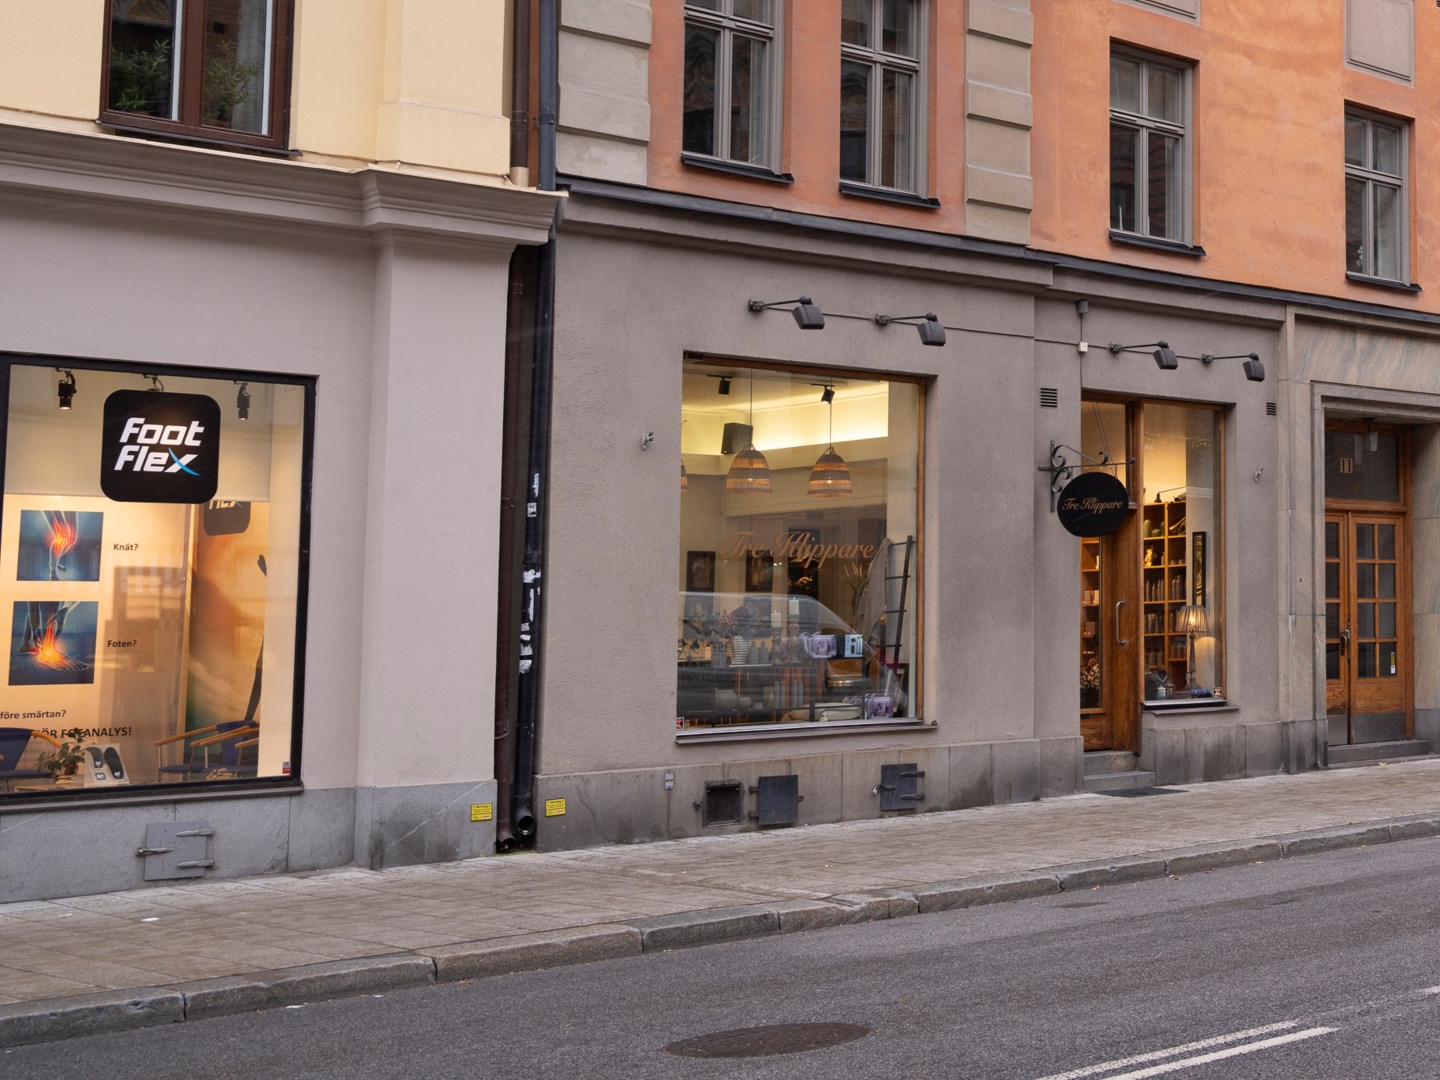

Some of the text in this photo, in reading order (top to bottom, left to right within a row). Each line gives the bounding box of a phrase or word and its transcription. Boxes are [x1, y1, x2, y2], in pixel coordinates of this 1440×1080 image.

[119, 417, 205, 446] Foot
[114, 445, 201, 476] Flex
[1062, 497, 1122, 514] Tre Klippare
[113, 543, 139, 551] Knät?
[770, 532, 877, 568] Klippare
[107, 640, 137, 648] Foten?
[22, 709, 67, 719] smärtan?
